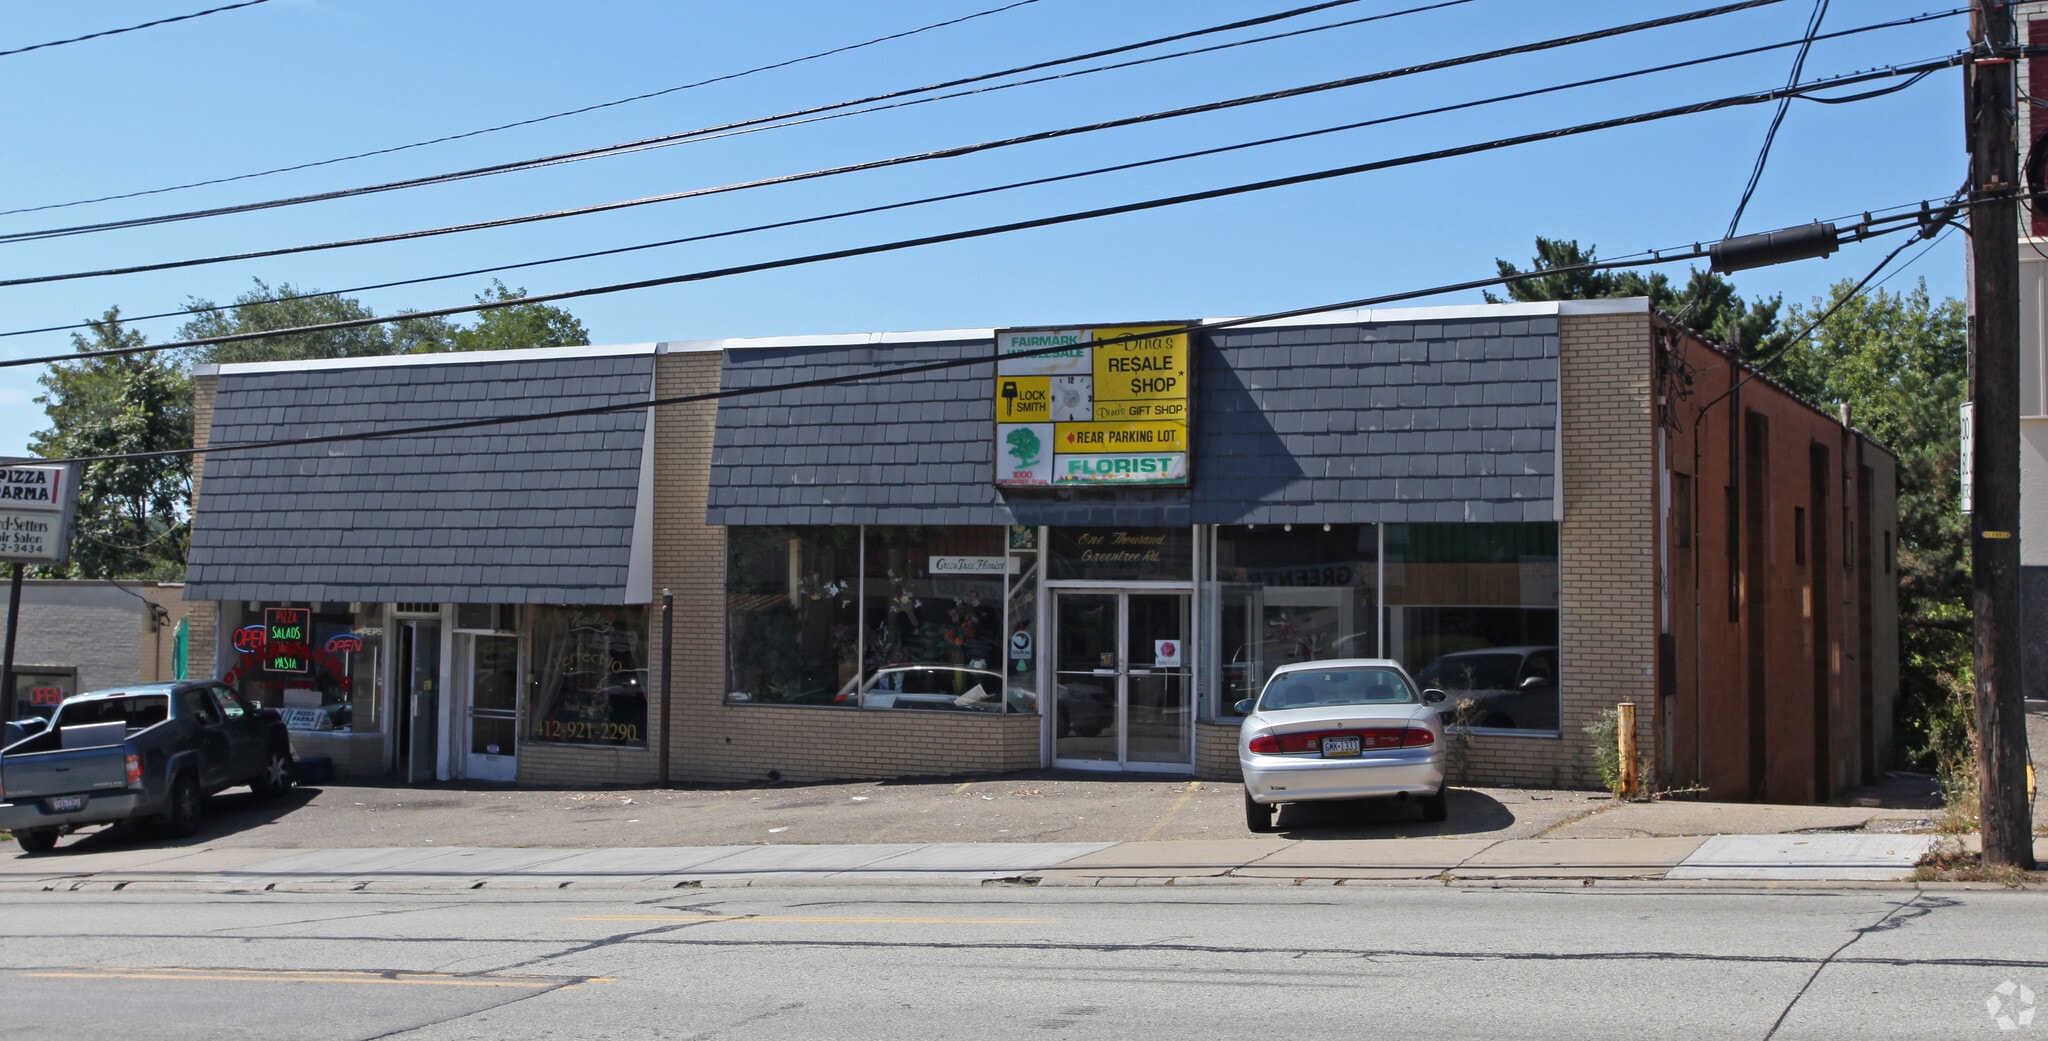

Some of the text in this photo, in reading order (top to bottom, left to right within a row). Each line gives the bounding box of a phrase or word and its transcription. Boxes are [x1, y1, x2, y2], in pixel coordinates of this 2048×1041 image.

[1011, 335, 1078, 347] FAIRMARK
[1067, 376, 1075, 384] 12
[1019, 390, 1046, 400] LOCK
[1016, 402, 1046, 412] SMITH
[1129, 406, 1151, 416] GIFT
[1154, 404, 1183, 415] SHOP
[1077, 430, 1176, 443] REAR PARKING LOT
[1068, 457, 1173, 474] FLORIST
[0, 486, 49, 500] ARMA
[13, 532, 42, 544] Salon
[1078, 531, 1166, 545] One Thousand
[1081, 549, 1141, 562] Greentree
[276, 611, 297, 624] PIZZA
[361, 627, 384, 636] PEPS
[233, 629, 266, 649] OPEN
[326, 639, 363, 652] OPEN
[31, 687, 63, 704] OPEN
[535, 721, 637, 740] 412-921-2290
